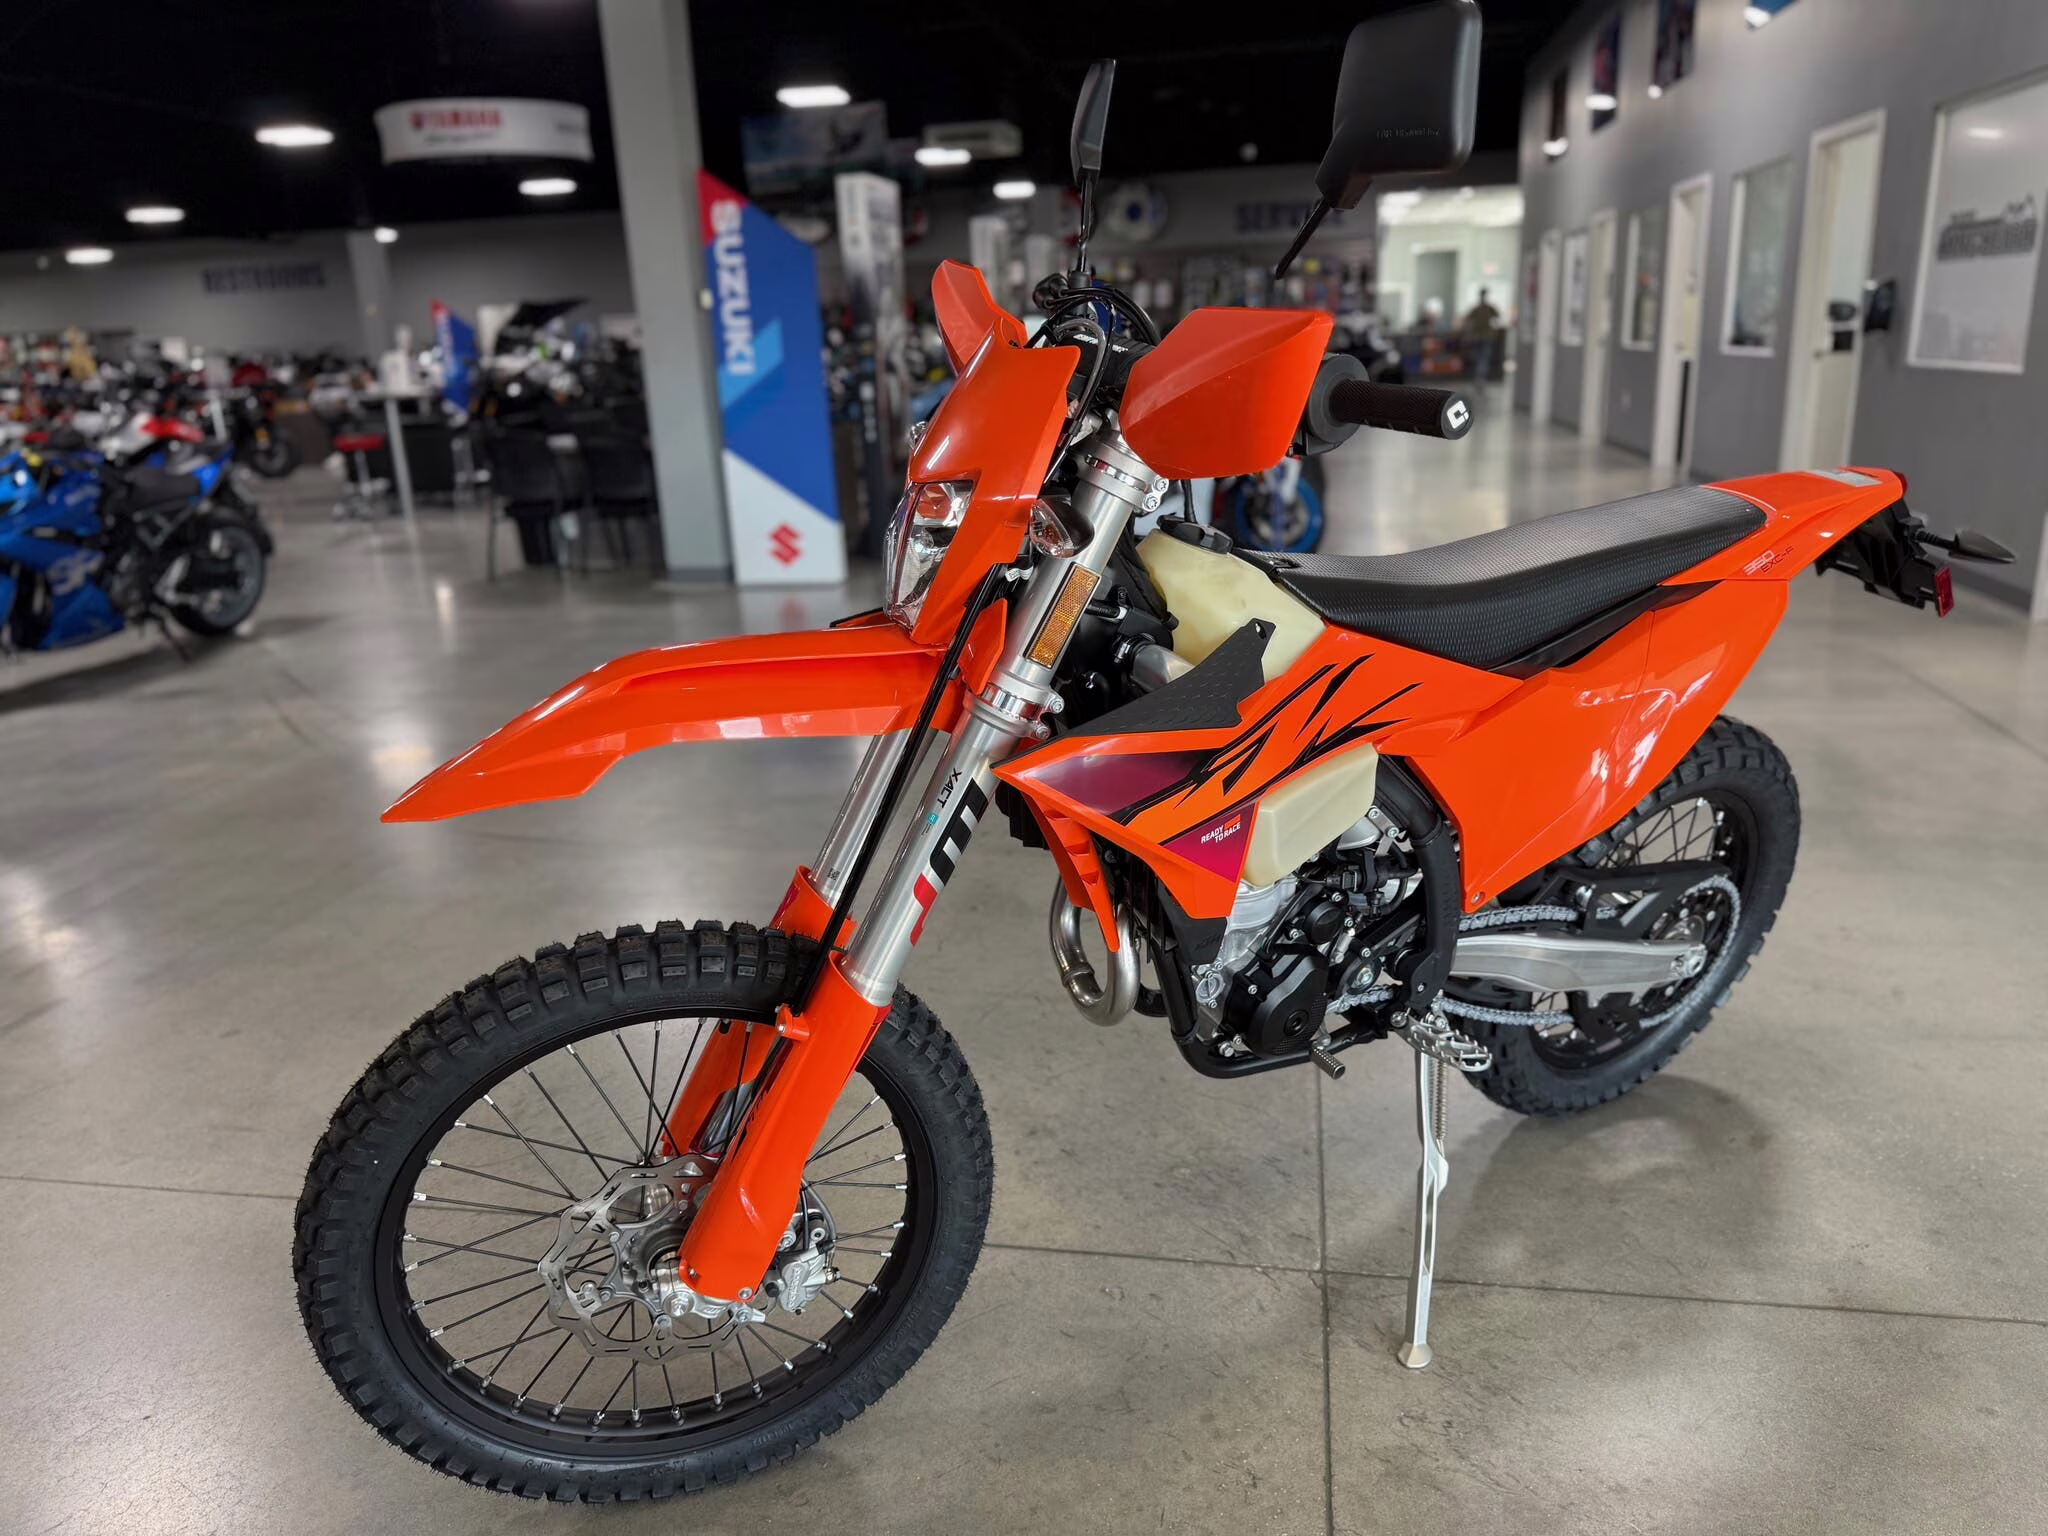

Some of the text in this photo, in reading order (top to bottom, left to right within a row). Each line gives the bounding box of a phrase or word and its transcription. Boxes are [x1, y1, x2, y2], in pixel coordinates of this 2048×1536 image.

[710, 199, 756, 376] SUZUKI
[1761, 545, 1794, 573] EXC-F
[937, 768, 963, 808] XACT
[1201, 824, 1224, 844] READY
[1224, 821, 1241, 838] RACE
